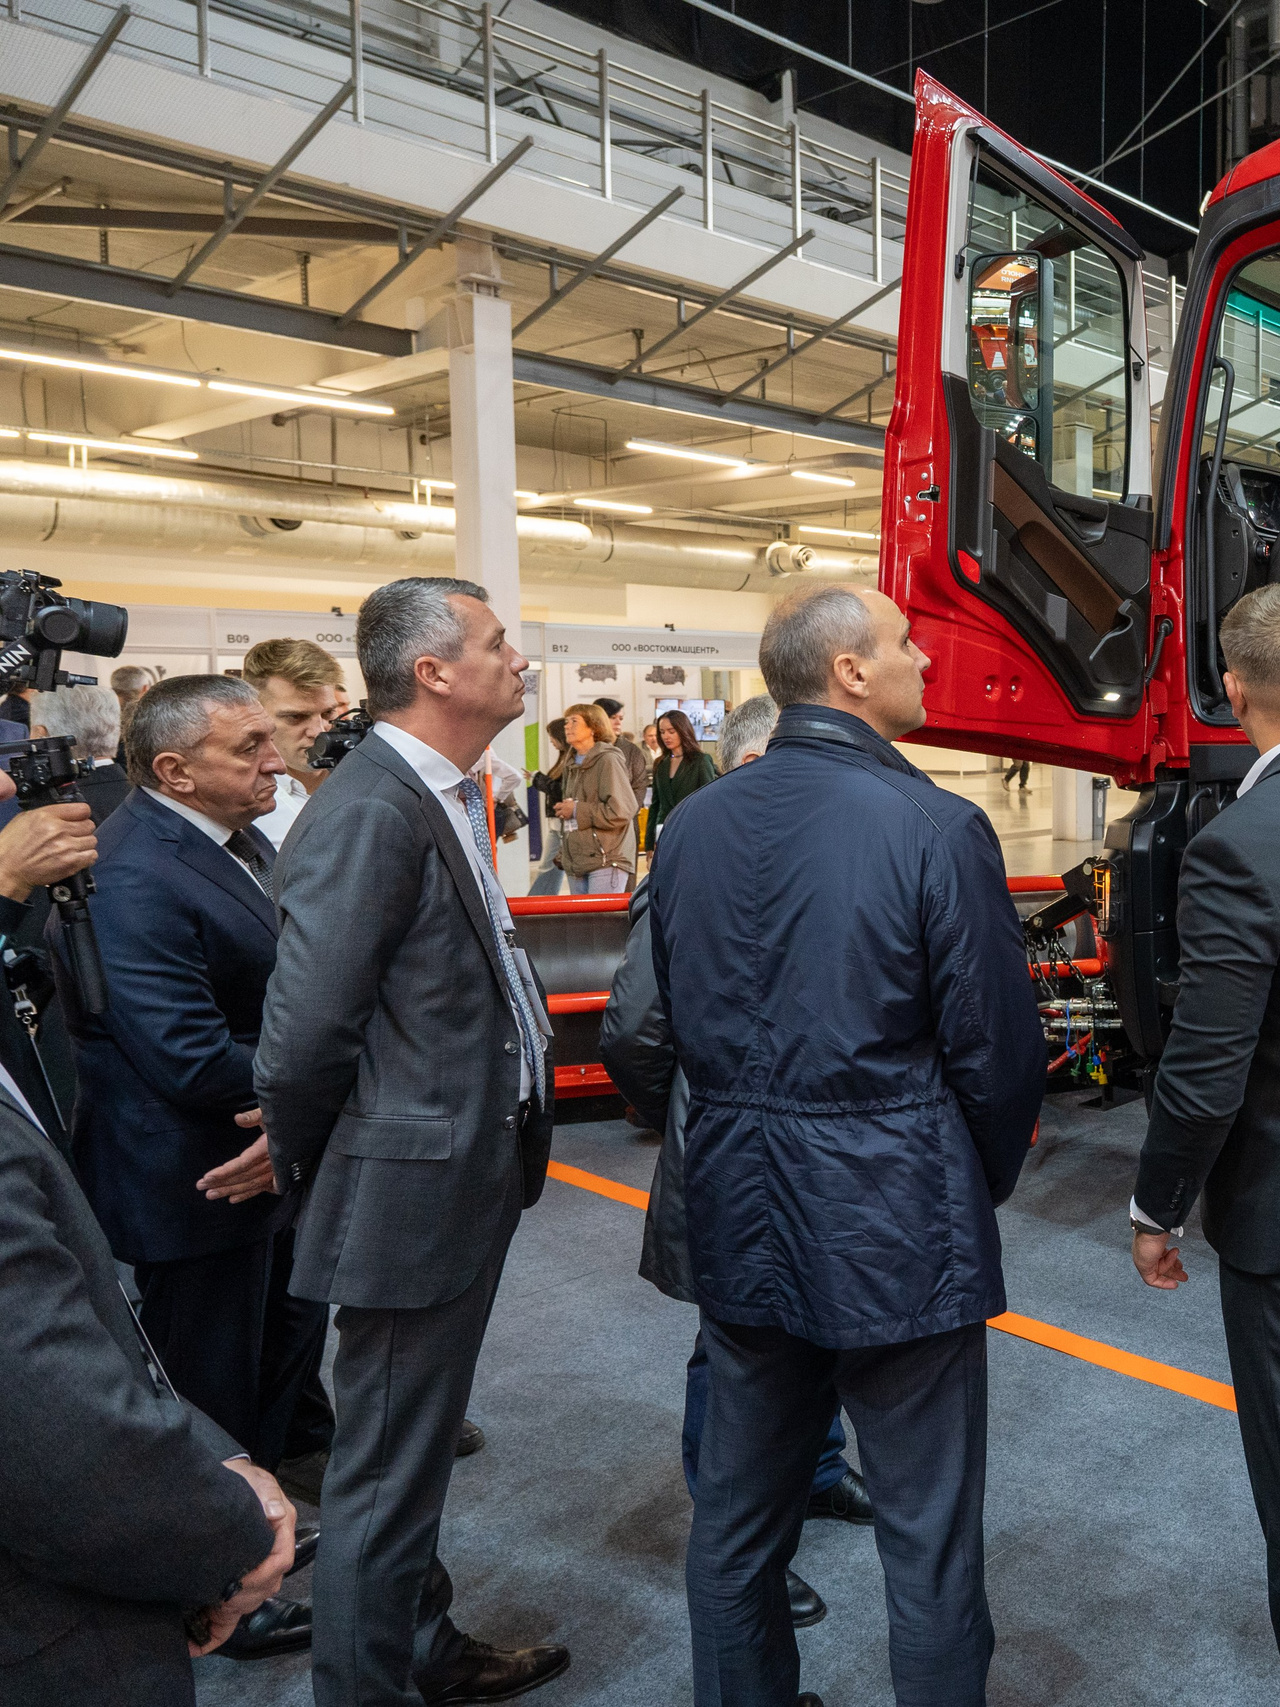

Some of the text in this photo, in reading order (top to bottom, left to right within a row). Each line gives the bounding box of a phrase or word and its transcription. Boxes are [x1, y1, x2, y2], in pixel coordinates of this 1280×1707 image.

[227, 634, 250, 643] B09
[316, 633, 343, 643] ООО
[552, 644, 569, 653] B12
[612, 643, 720, 655] ООО «ВОСТОКМАШЦЕНТР»
